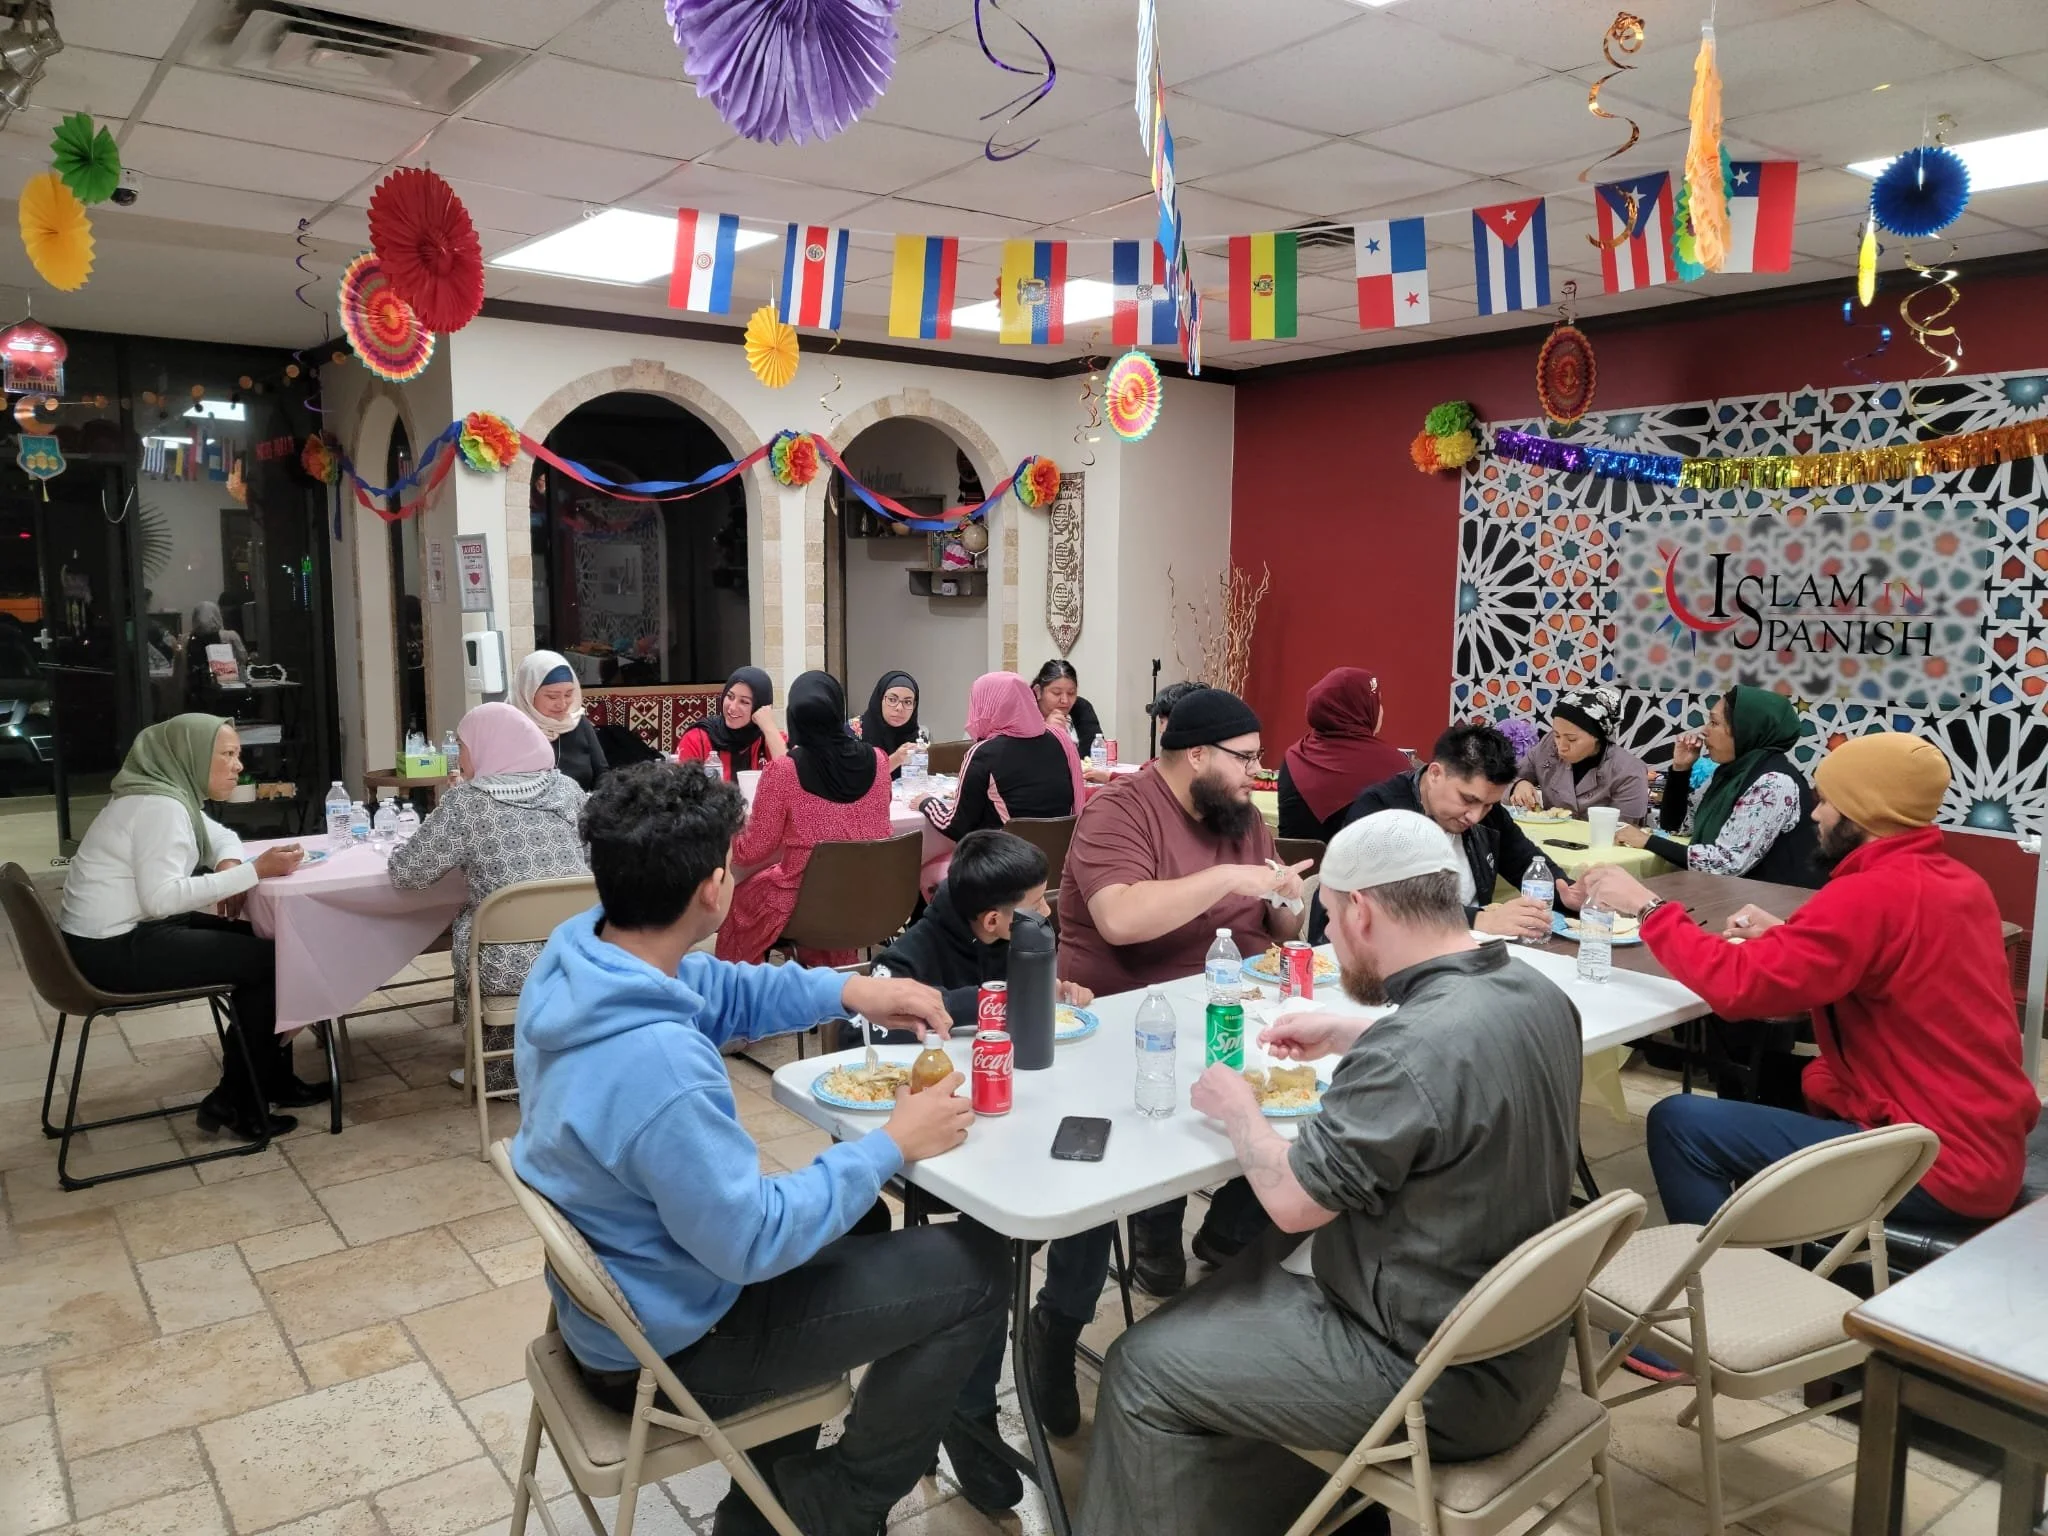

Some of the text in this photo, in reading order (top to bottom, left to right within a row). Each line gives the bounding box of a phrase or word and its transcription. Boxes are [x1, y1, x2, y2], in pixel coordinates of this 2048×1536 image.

[463, 545, 481, 554] AVISO
[1708, 553, 1925, 618] ISLAM IN
[1733, 575, 1934, 656] SPANISH
